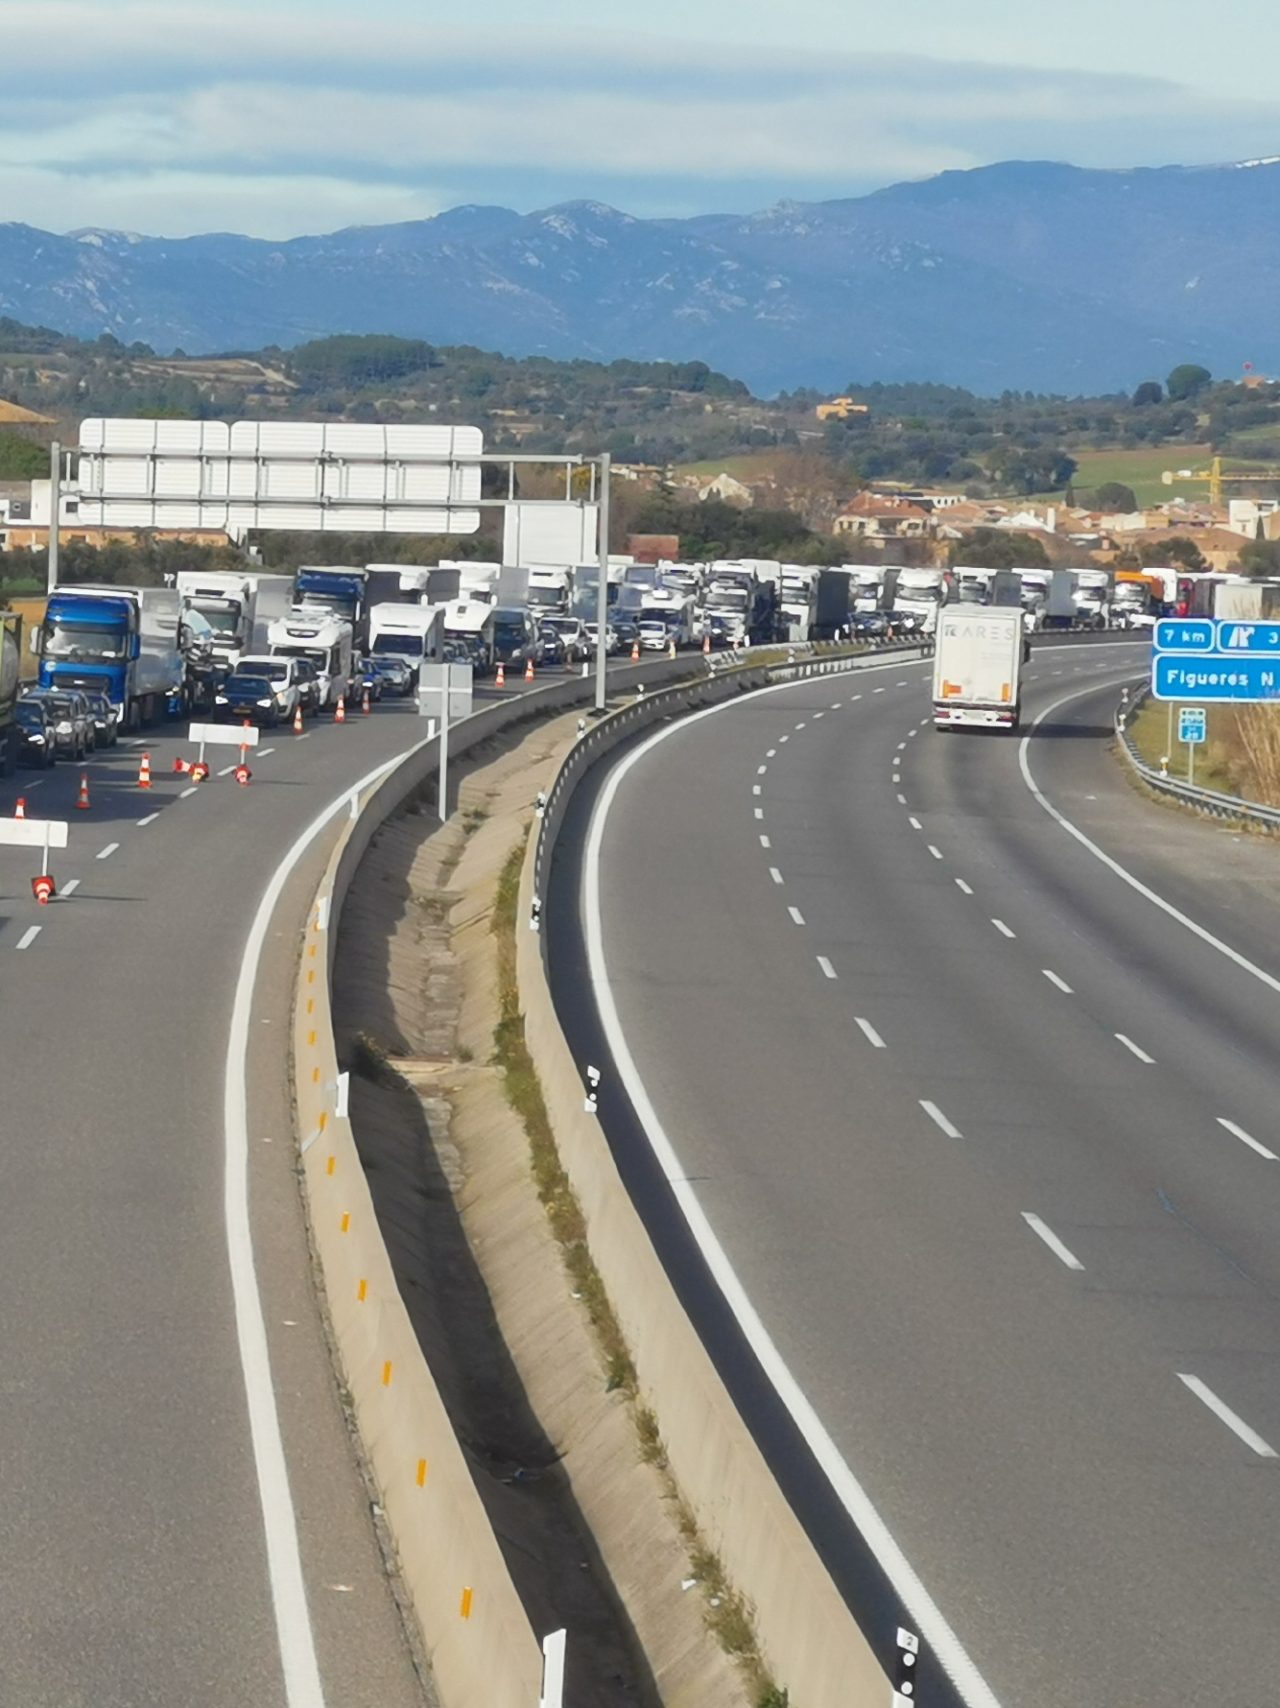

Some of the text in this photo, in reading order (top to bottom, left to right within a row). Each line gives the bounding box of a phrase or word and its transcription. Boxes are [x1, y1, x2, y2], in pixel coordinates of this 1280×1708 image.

[1164, 629, 1205, 643] 7 km
[1268, 631, 1279, 644] 3
[1166, 669, 1249, 688] Figueres
